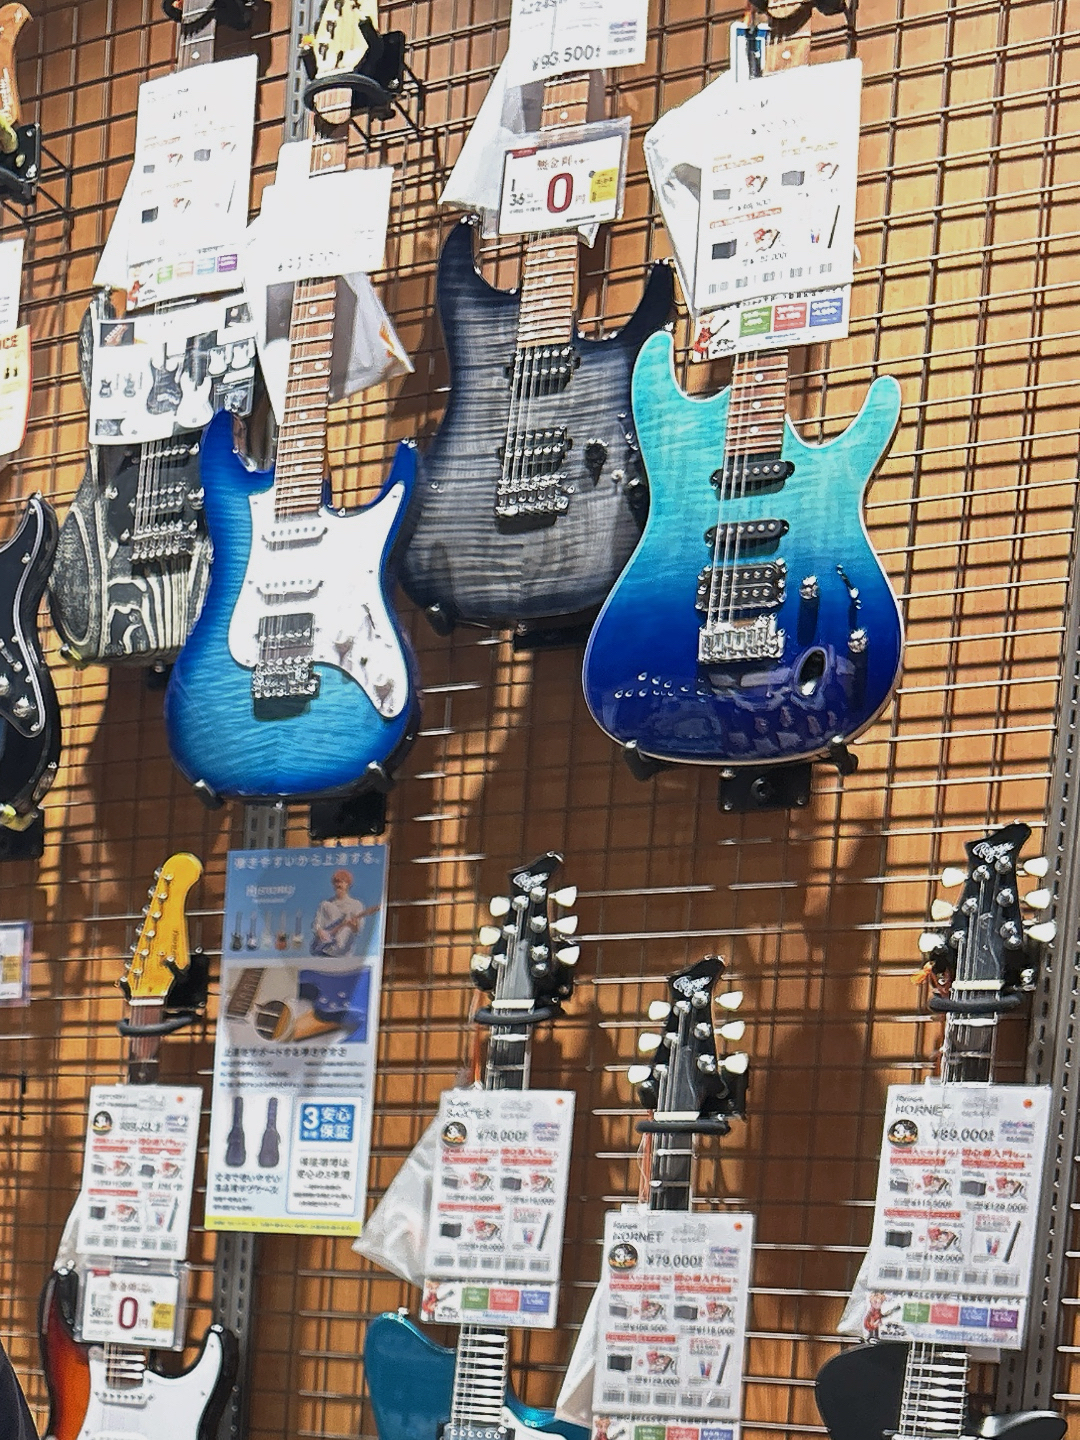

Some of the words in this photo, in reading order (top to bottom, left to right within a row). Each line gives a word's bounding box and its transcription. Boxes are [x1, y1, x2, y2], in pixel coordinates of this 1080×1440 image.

[547, 173, 573, 213] 0
[303, 1107, 319, 1130] 3
[119, 1296, 139, 1330] 0
